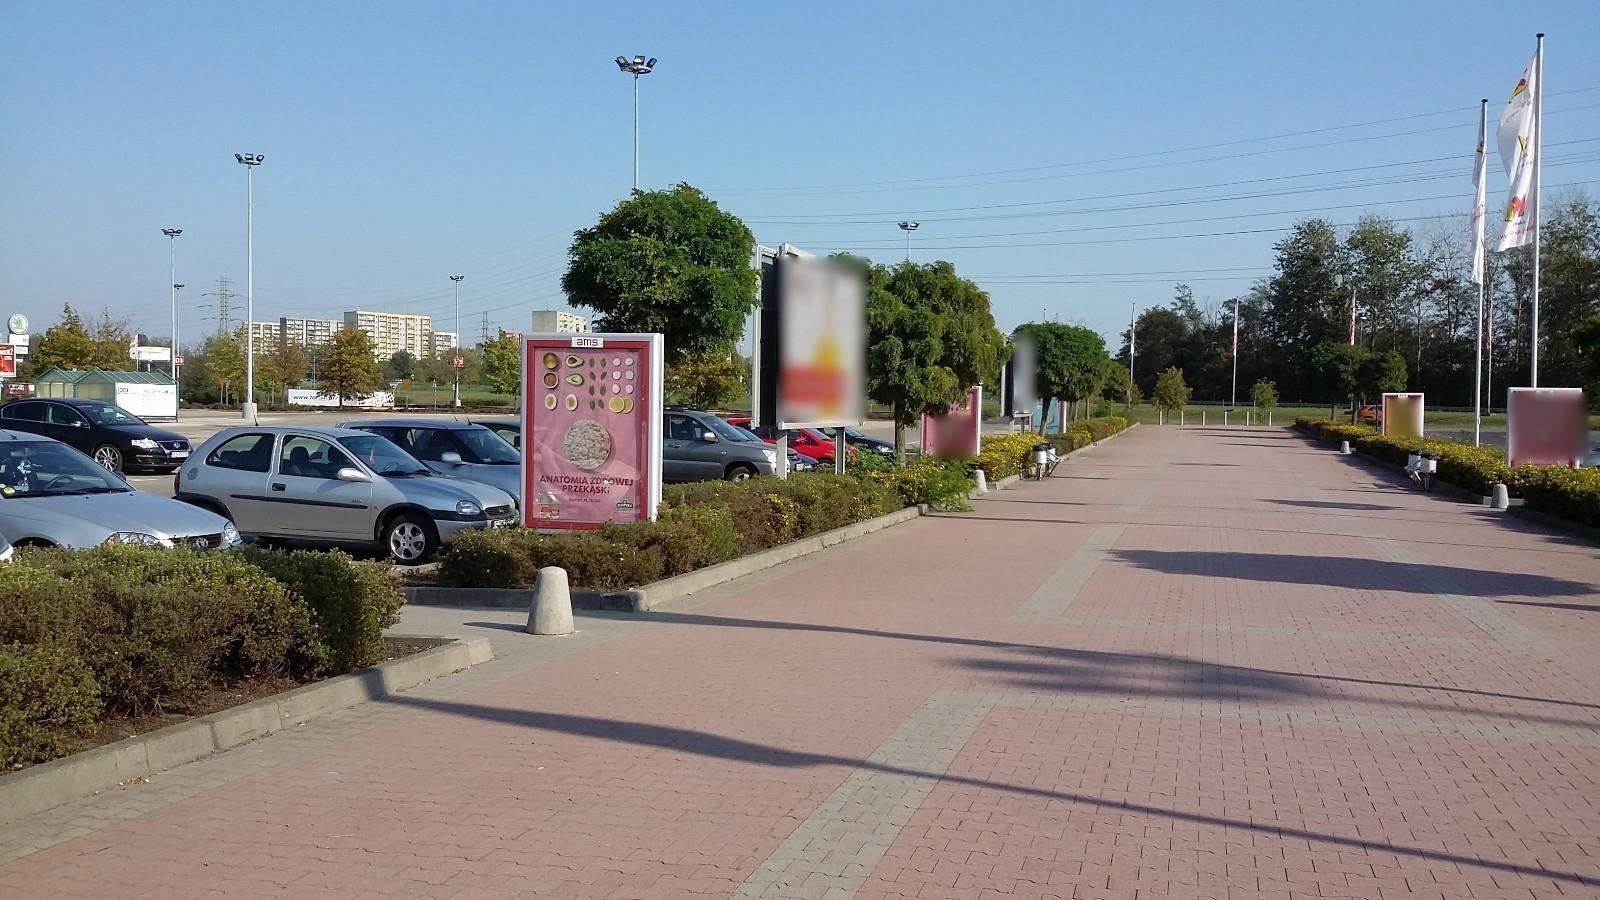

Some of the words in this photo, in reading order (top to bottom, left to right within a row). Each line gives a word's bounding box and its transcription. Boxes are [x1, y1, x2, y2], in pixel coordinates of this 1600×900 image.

[577, 338, 598, 346] ams
[540, 475, 588, 485] ANATOMIA
[590, 476, 633, 487] ZDROWEJ
[562, 484, 610, 495] PRZEKĄSKI
